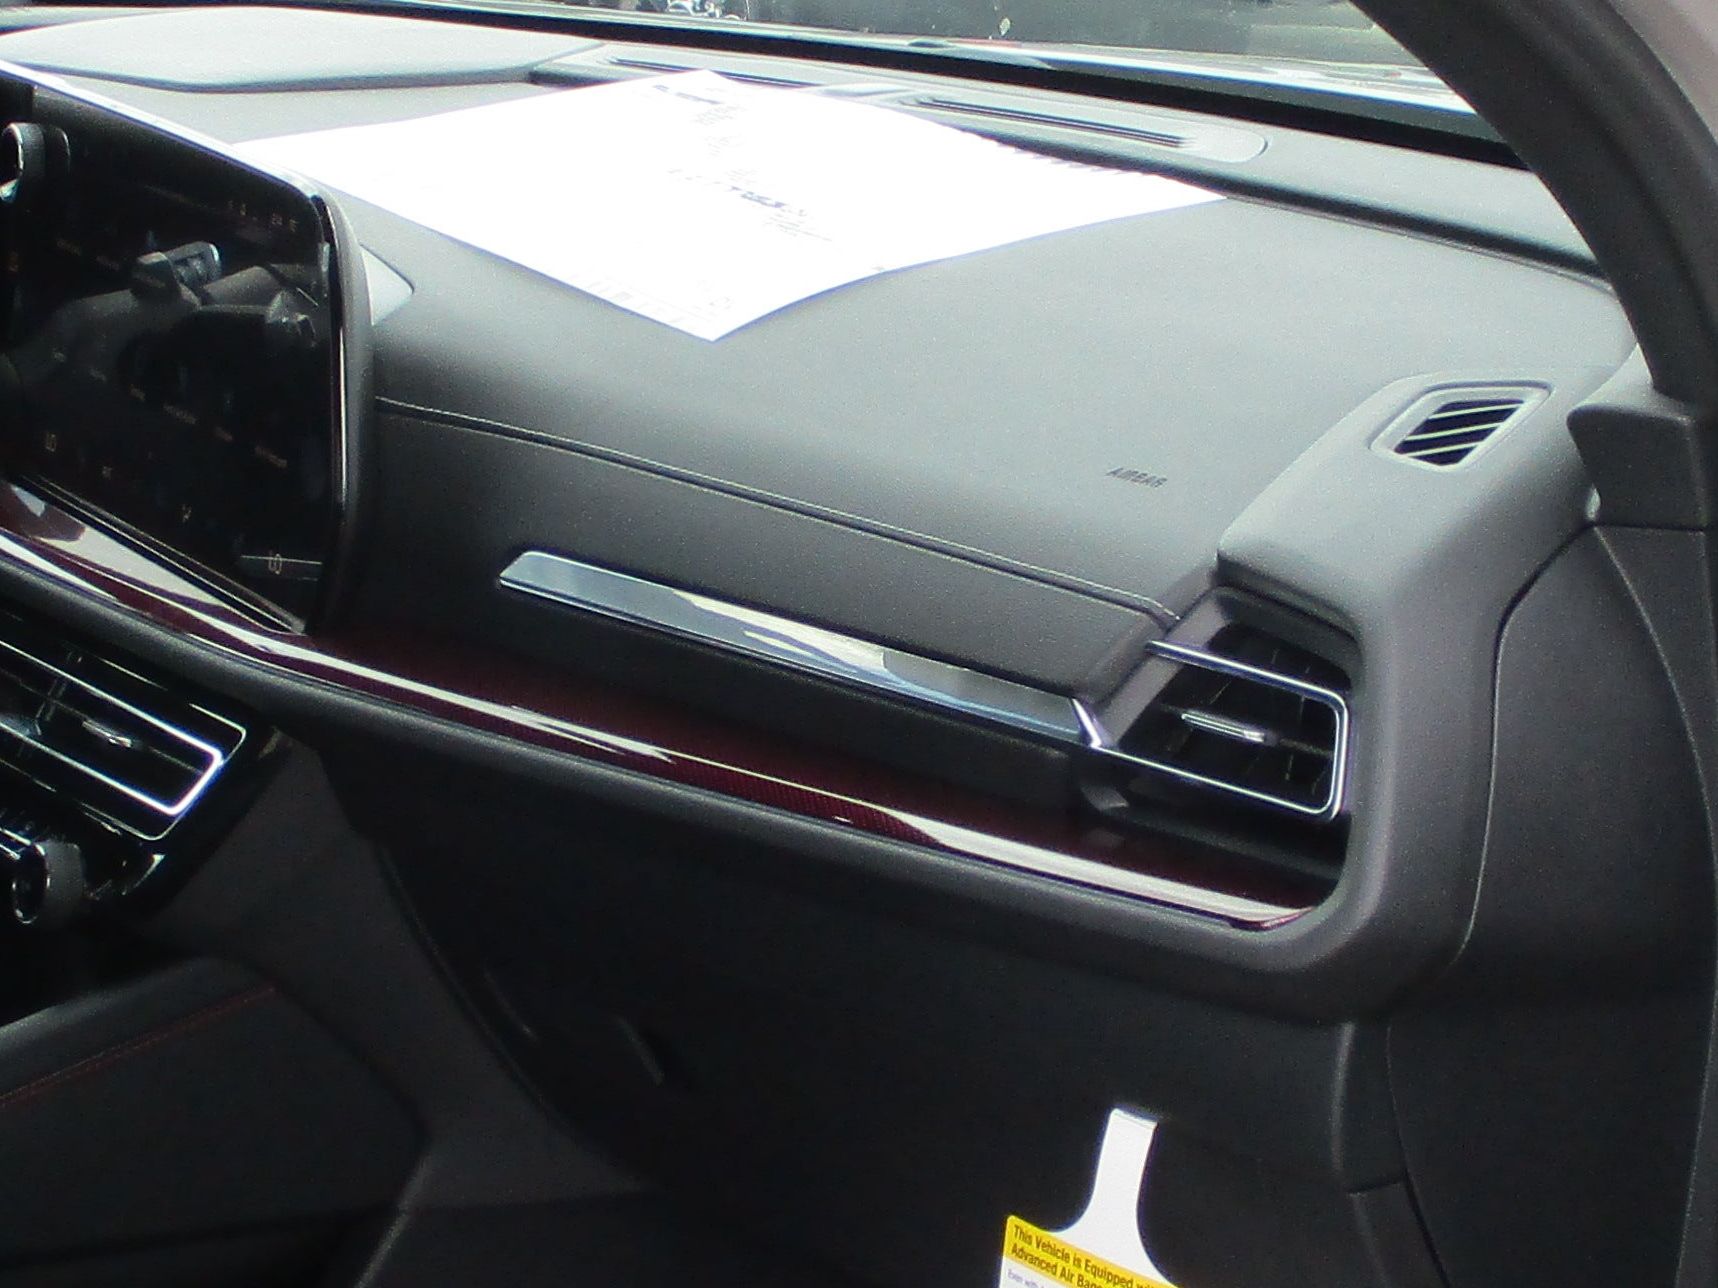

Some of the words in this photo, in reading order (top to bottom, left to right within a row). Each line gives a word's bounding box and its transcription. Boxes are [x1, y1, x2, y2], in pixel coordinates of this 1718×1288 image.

[1010, 1242, 1057, 1276] Advanced
[1059, 1265, 1074, 1284] Air
[1013, 1224, 1033, 1245] This
[1034, 1236, 1070, 1263] Vehicle
[1072, 1253, 1082, 1268] is
